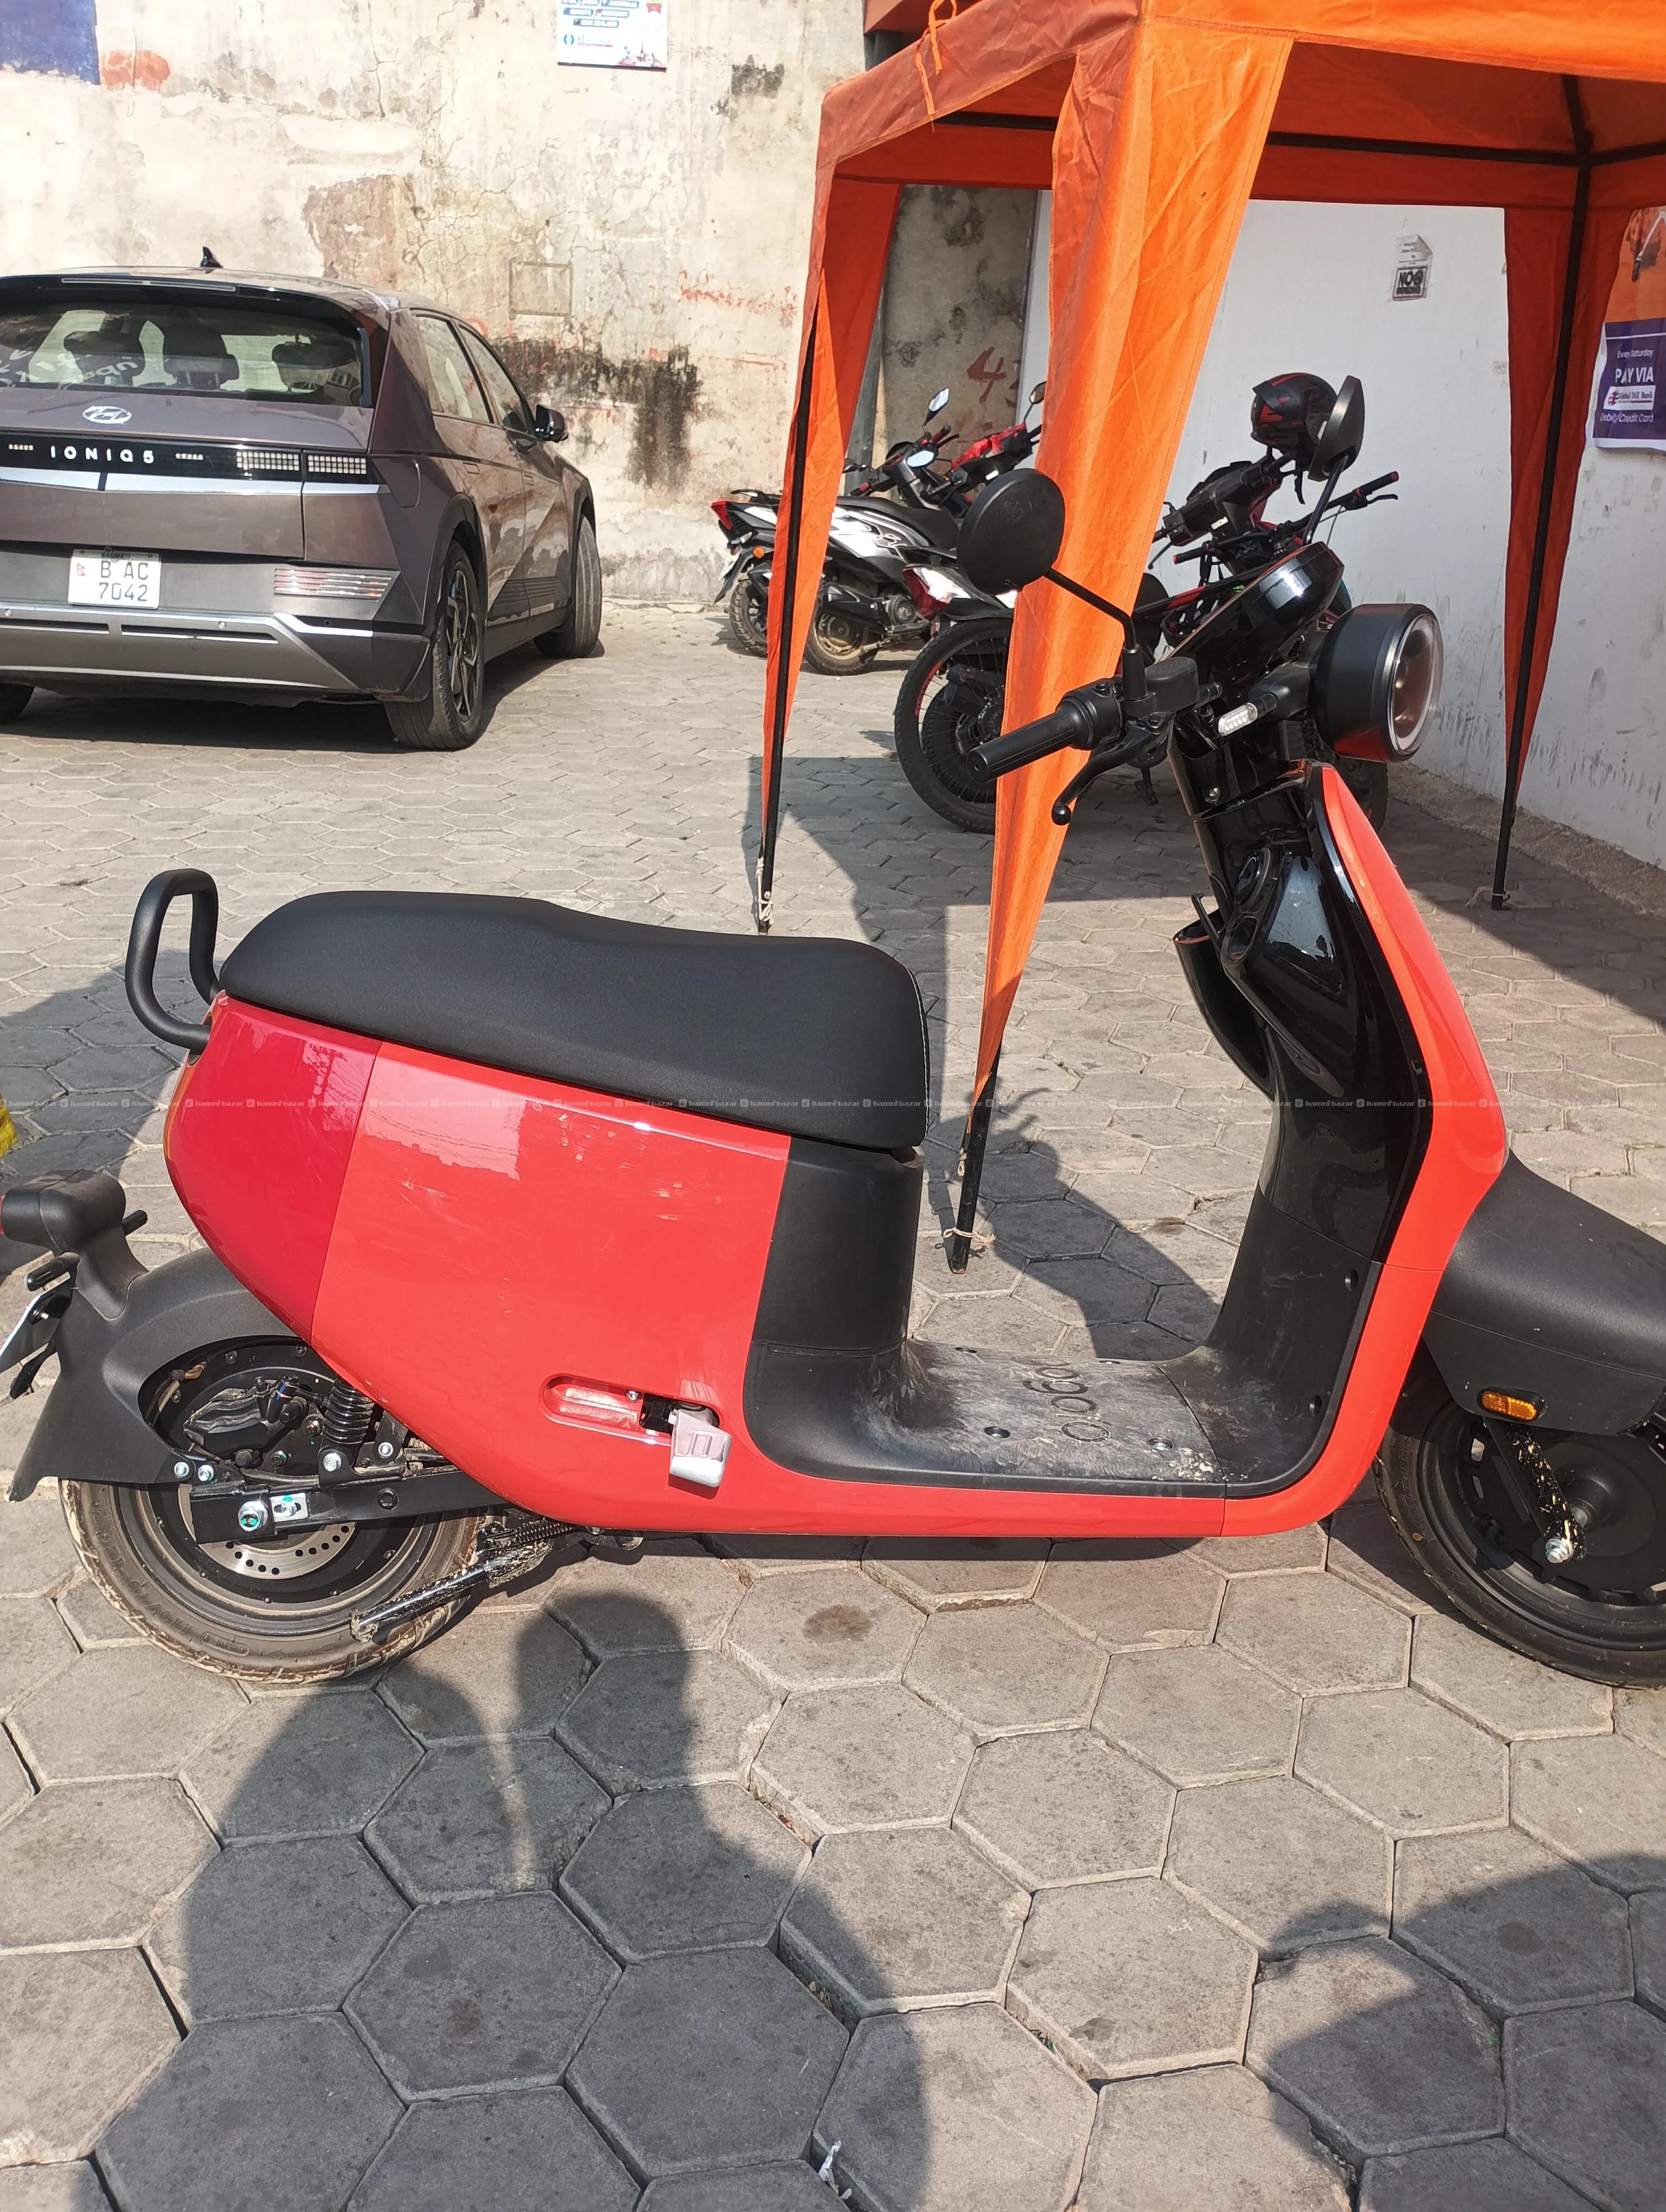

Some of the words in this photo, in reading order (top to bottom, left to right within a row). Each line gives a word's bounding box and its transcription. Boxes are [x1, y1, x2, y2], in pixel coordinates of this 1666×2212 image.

[1631, 348, 1654, 358] Saturday
[1615, 368, 1634, 383] PAY
[1636, 366, 1654, 383] VIA
[1638, 413, 1654, 423] Card
[50, 445, 133, 462] IONIQ
[143, 450, 154, 464] 5
[100, 560, 111, 578] B
[124, 562, 149, 580] AC
[98, 582, 148, 602] 7042
